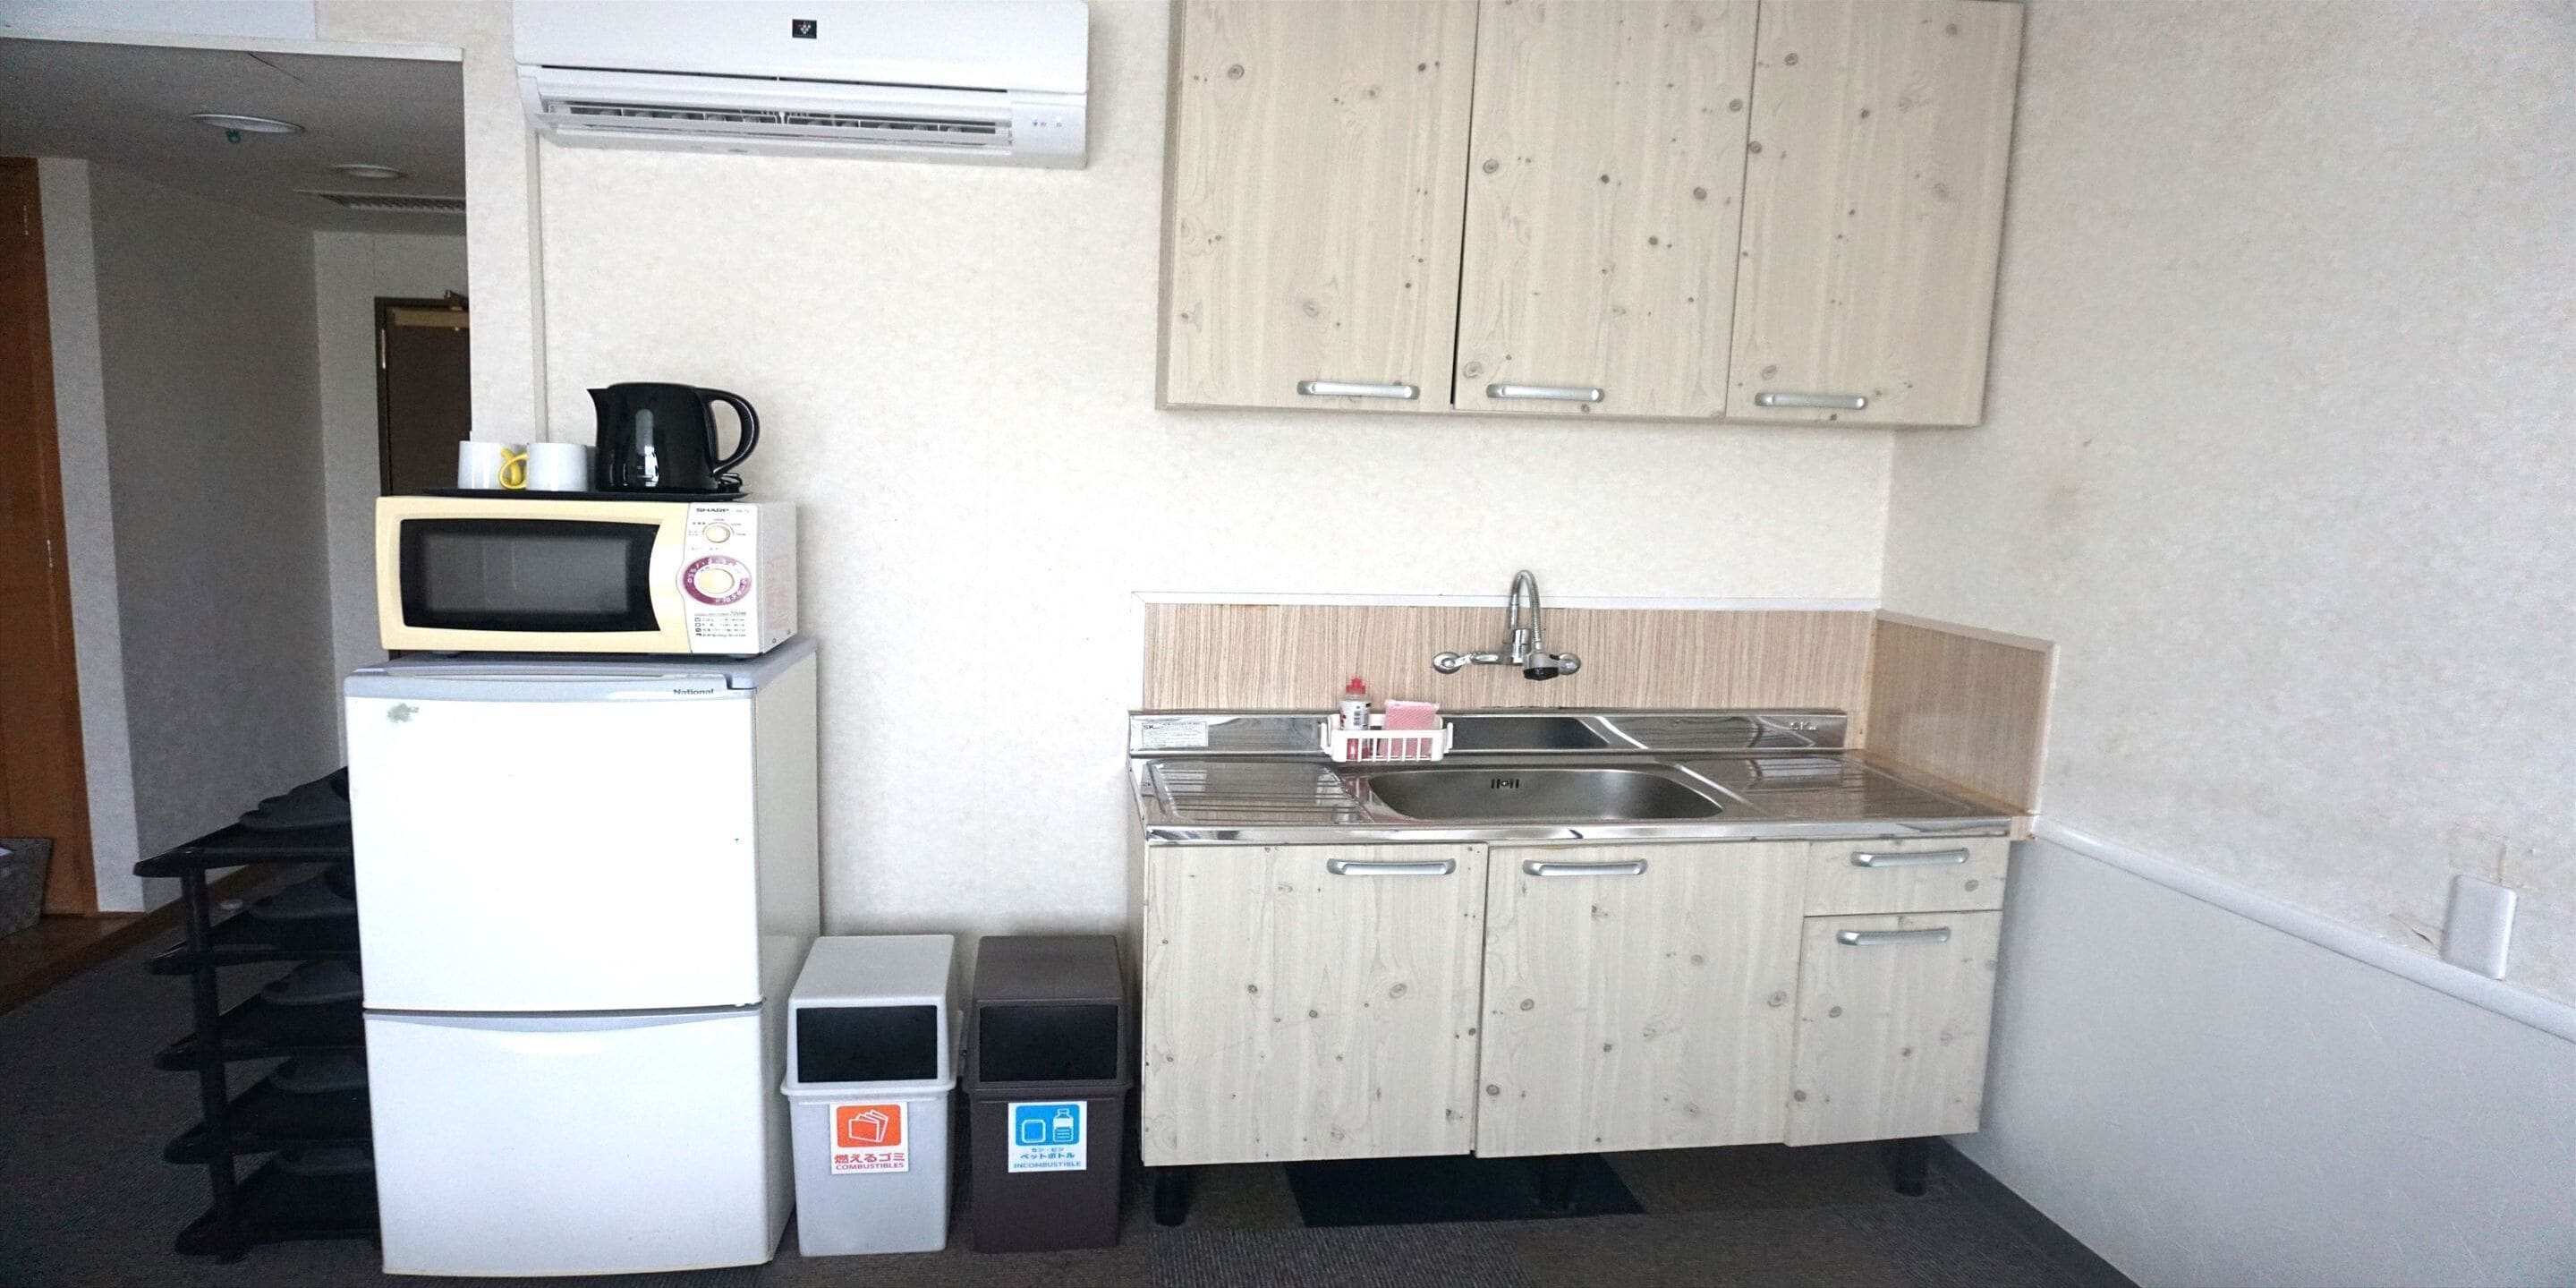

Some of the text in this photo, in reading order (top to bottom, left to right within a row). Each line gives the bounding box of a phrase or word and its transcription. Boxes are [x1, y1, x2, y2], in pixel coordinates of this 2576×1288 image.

[834, 1152, 905, 1164] 燃えるゴミ
[1020, 1152, 1075, 1160] ペットボトル
[836, 1163, 905, 1171] COMBUSTIBLES
[1014, 1161, 1082, 1169] INCOMBUSTIBLE
